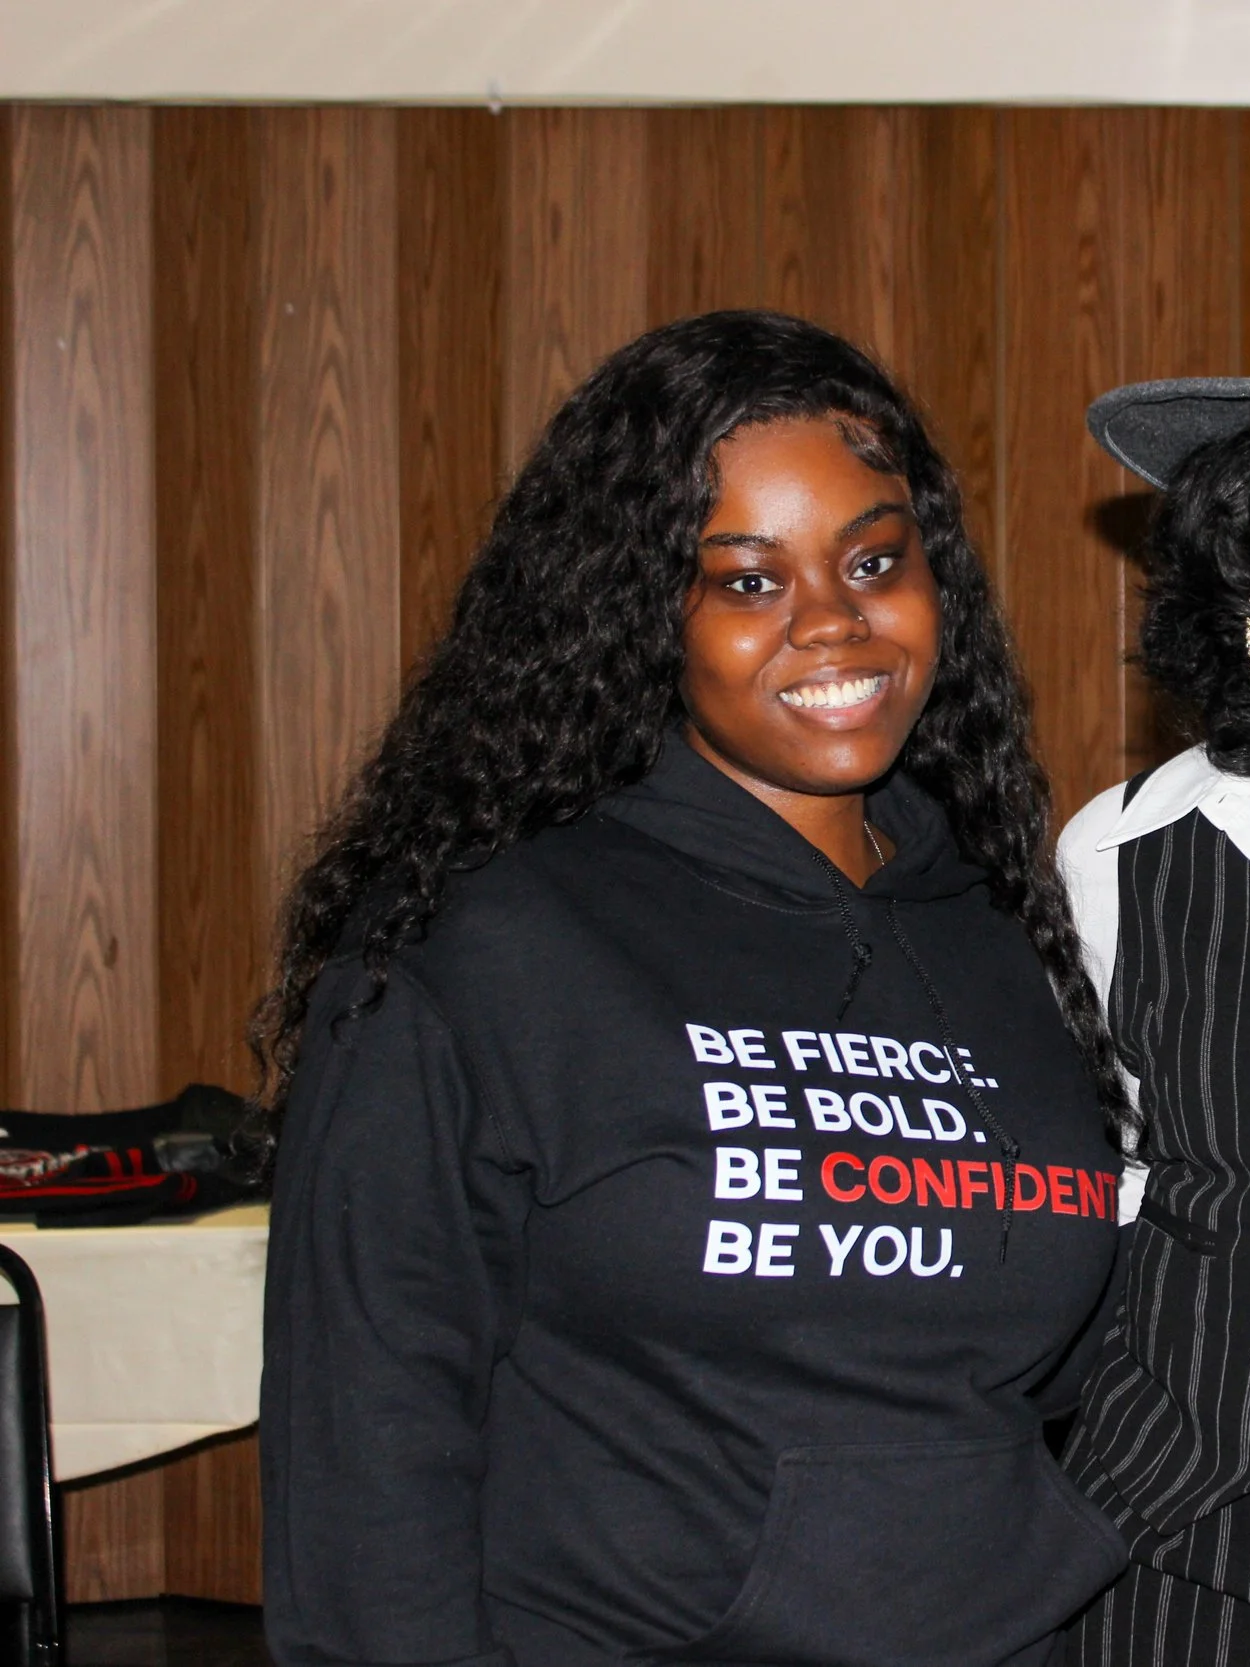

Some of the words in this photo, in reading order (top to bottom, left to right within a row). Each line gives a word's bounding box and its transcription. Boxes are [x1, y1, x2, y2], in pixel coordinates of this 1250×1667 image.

[685, 1023, 776, 1069] BE
[781, 1031, 999, 1088] FIERCE.
[703, 1082, 796, 1131] BE
[804, 1087, 987, 1143] BOLD.
[714, 1146, 803, 1201] BE
[820, 1151, 1117, 1223] CONFIDENT
[702, 1219, 800, 1277] BE
[818, 1224, 964, 1278] YOU.
